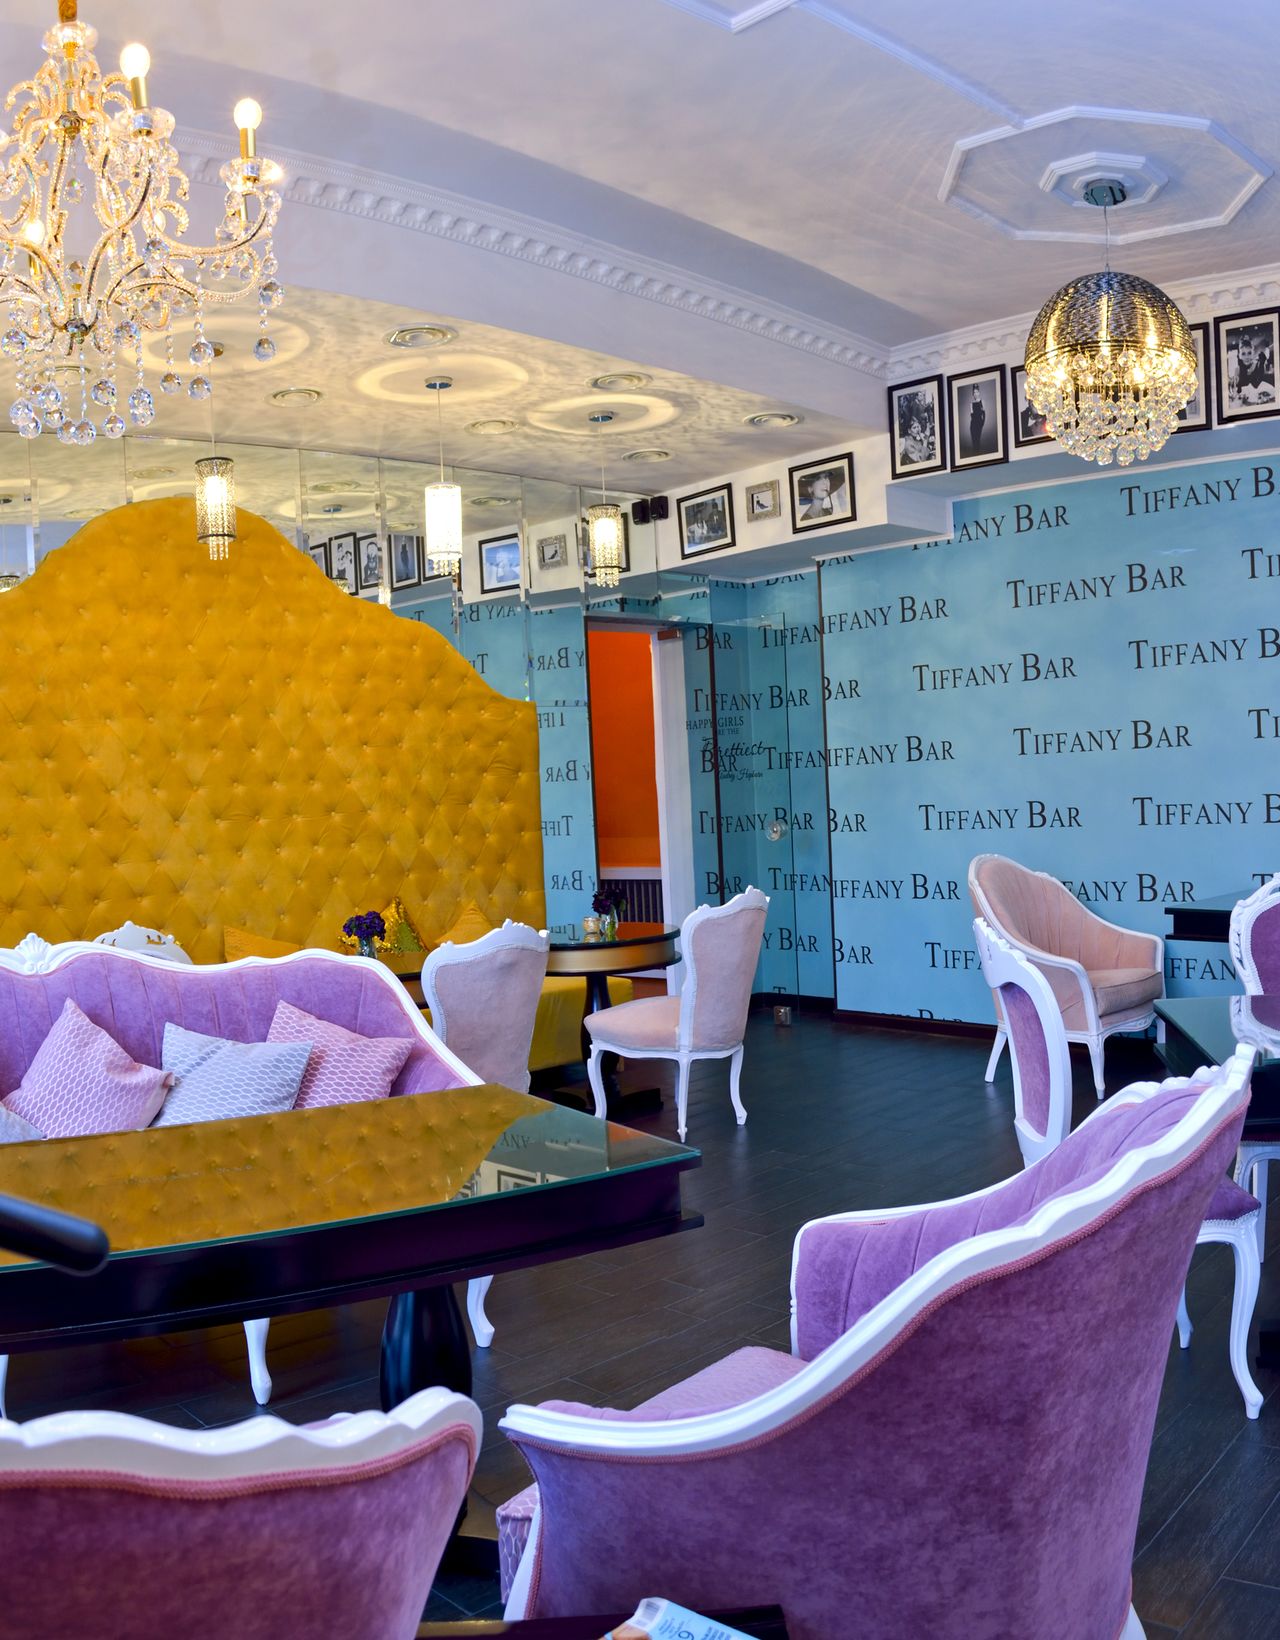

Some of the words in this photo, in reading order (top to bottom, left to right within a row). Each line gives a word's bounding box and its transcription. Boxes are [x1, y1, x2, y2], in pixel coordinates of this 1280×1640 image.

[1120, 477, 1241, 516] TIFFANY
[1014, 503, 1070, 534] BAR
[1006, 574, 1116, 609] TIFFANY
[1125, 562, 1187, 594] BAR
[823, 606, 892, 634] IFFANY
[898, 596, 949, 623] BAR
[758, 624, 822, 648] TIFFAN
[1128, 638, 1249, 670] TIFFANY
[912, 662, 1012, 692] TIFFANY
[1020, 653, 1077, 682] BAR
[769, 685, 810, 708] BAR
[828, 744, 898, 767] IFFANY
[905, 736, 955, 762] BAR
[1013, 727, 1122, 756] TIFFANY
[1130, 720, 1192, 749] BAR
[764, 747, 827, 770] TIFFAN
[918, 804, 1018, 831] TIFFANY
[1026, 800, 1083, 829] BAR
[1133, 797, 1253, 826] TIFFANY
[768, 868, 831, 891] TIFFAN
[833, 880, 904, 899] IFFANY
[911, 873, 960, 900] BAR
[1136, 873, 1196, 903] BAR
[778, 927, 819, 952] BAR
[924, 942, 982, 970] TIFF
